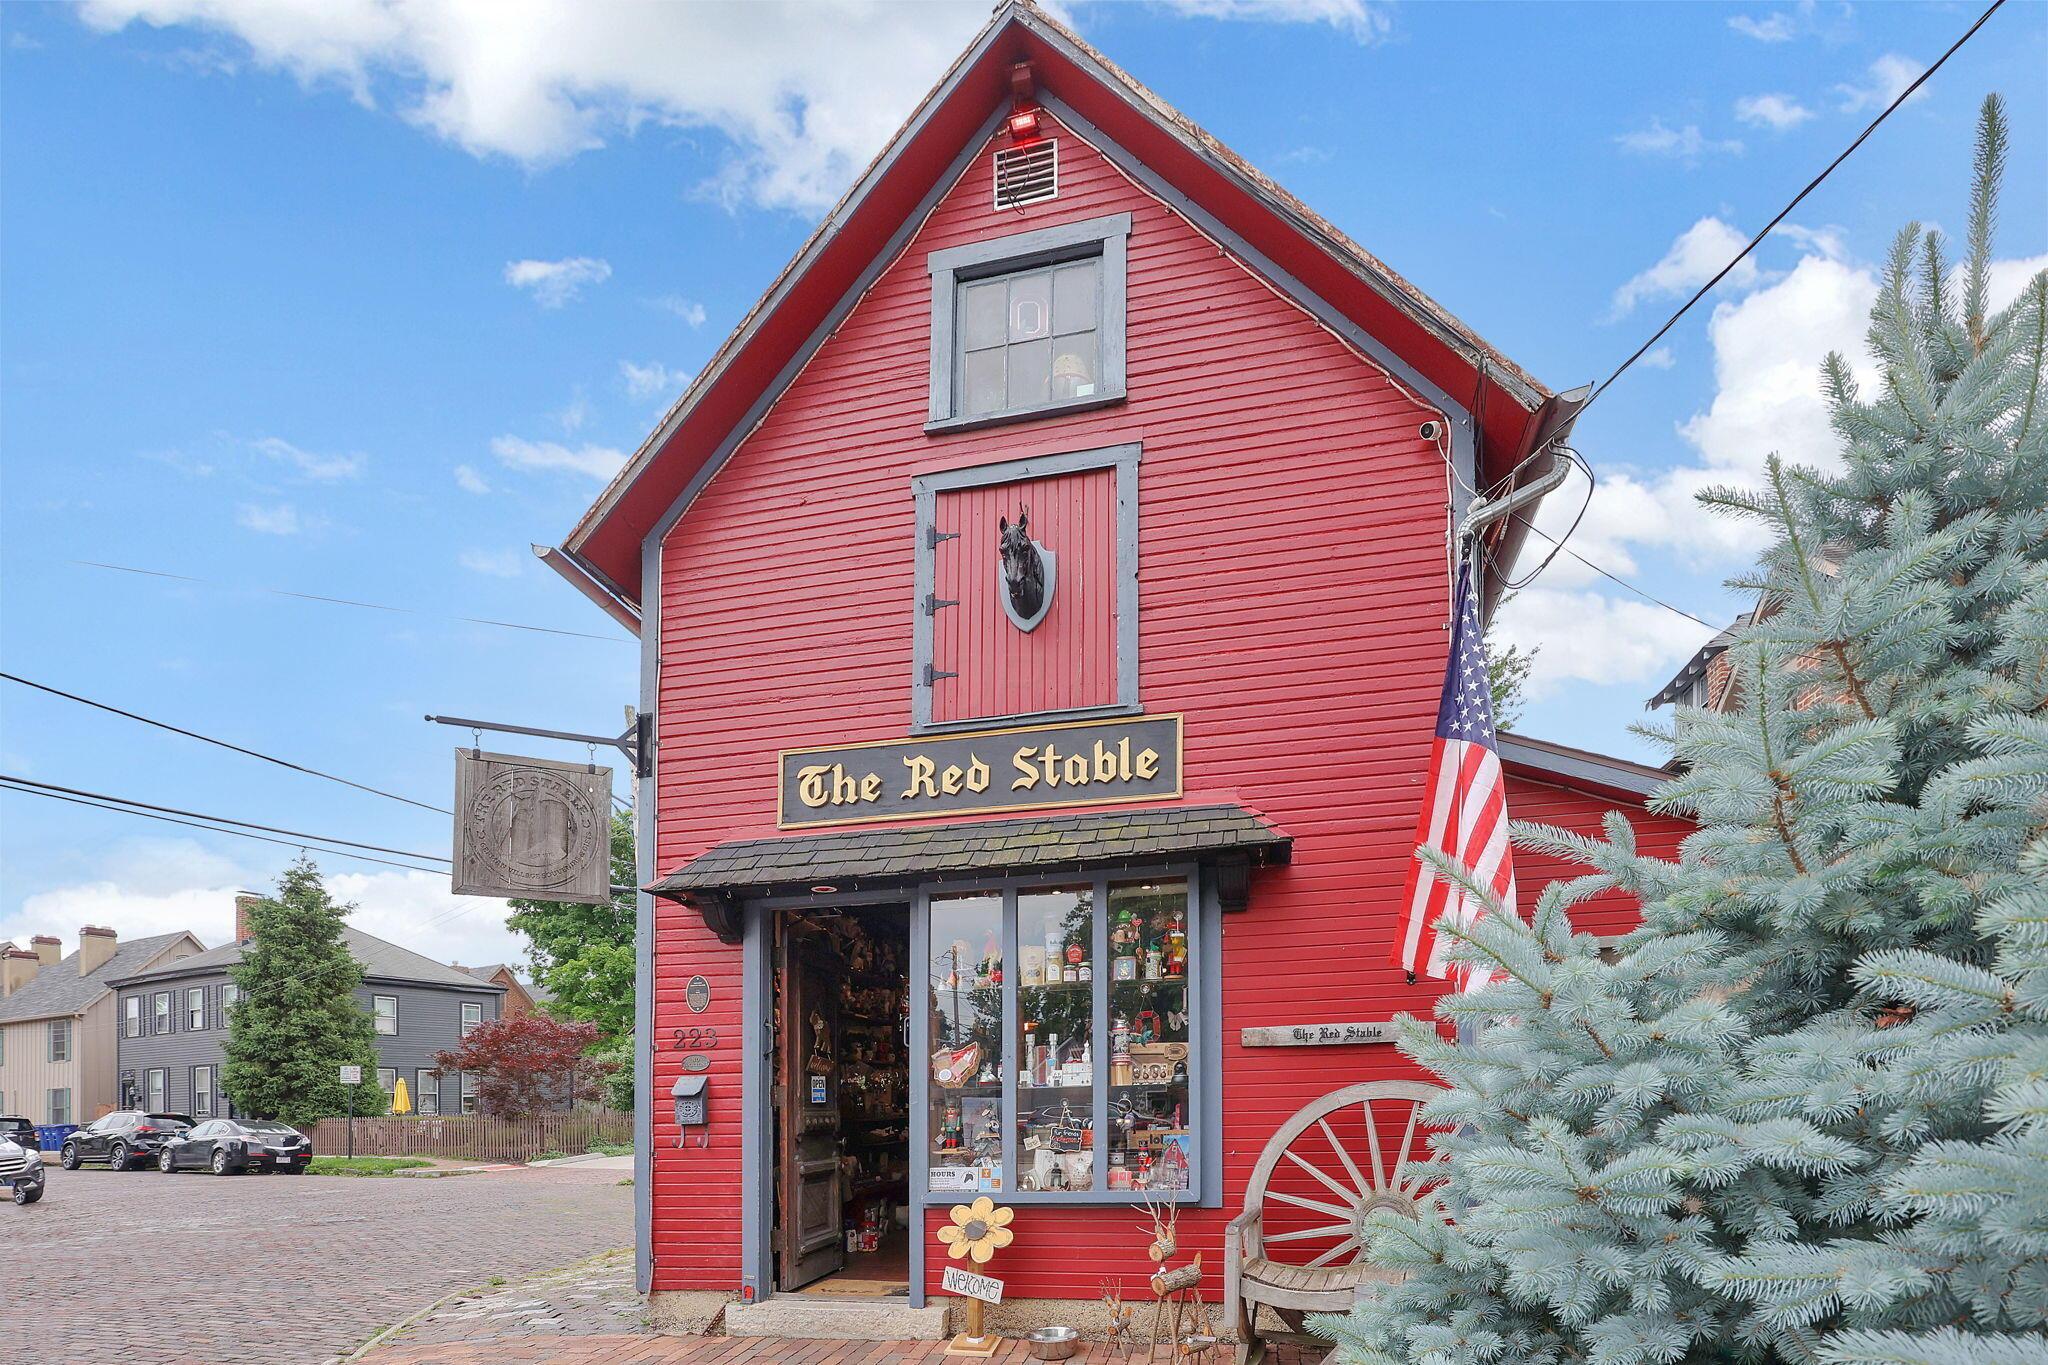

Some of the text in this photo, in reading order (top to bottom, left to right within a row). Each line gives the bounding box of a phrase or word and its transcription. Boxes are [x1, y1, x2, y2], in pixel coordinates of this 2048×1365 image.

[797, 736, 1160, 808] The Red Stable
[474, 776, 589, 826] THE RED STABLE
[673, 1027, 718, 1049] 223
[1293, 1026, 1382, 1042] The Red Stable
[812, 1079, 825, 1089] OPEN
